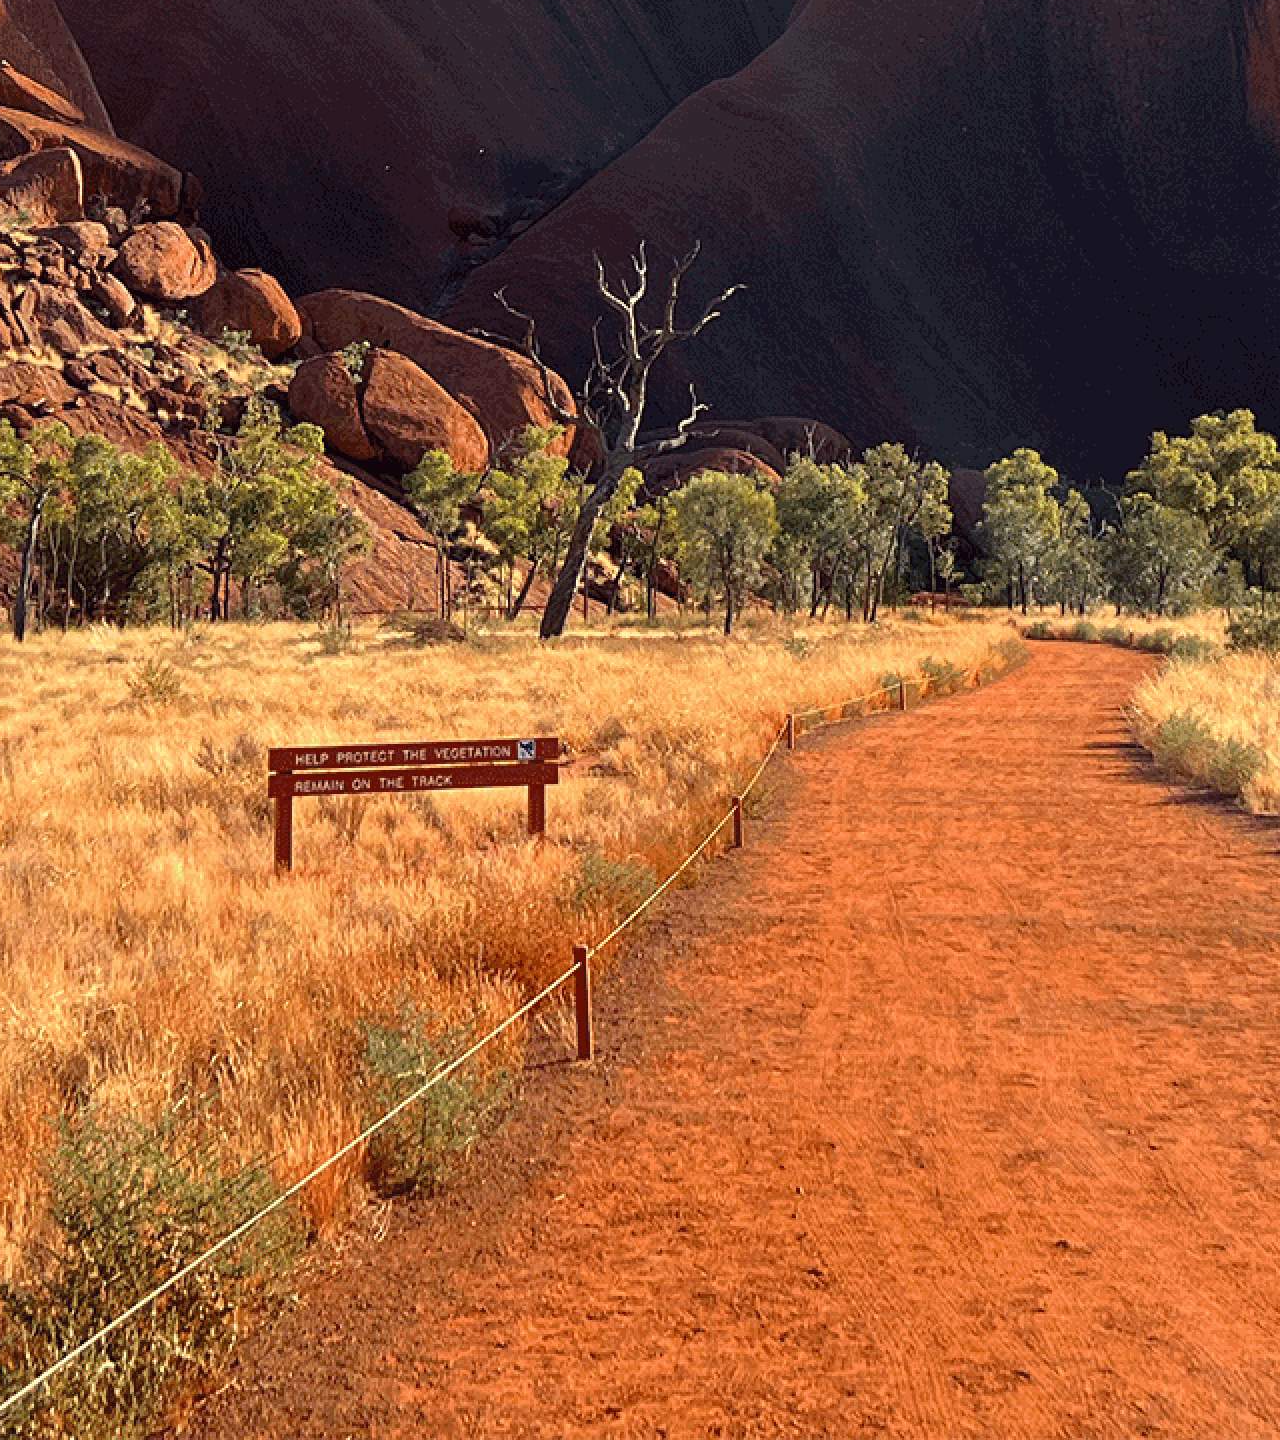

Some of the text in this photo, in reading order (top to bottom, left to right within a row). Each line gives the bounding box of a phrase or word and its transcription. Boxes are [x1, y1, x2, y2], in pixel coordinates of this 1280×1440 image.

[295, 745, 511, 765] HELP PROTECT THE VEGETATION
[295, 775, 452, 792] REMAIN ON THE TRACK
